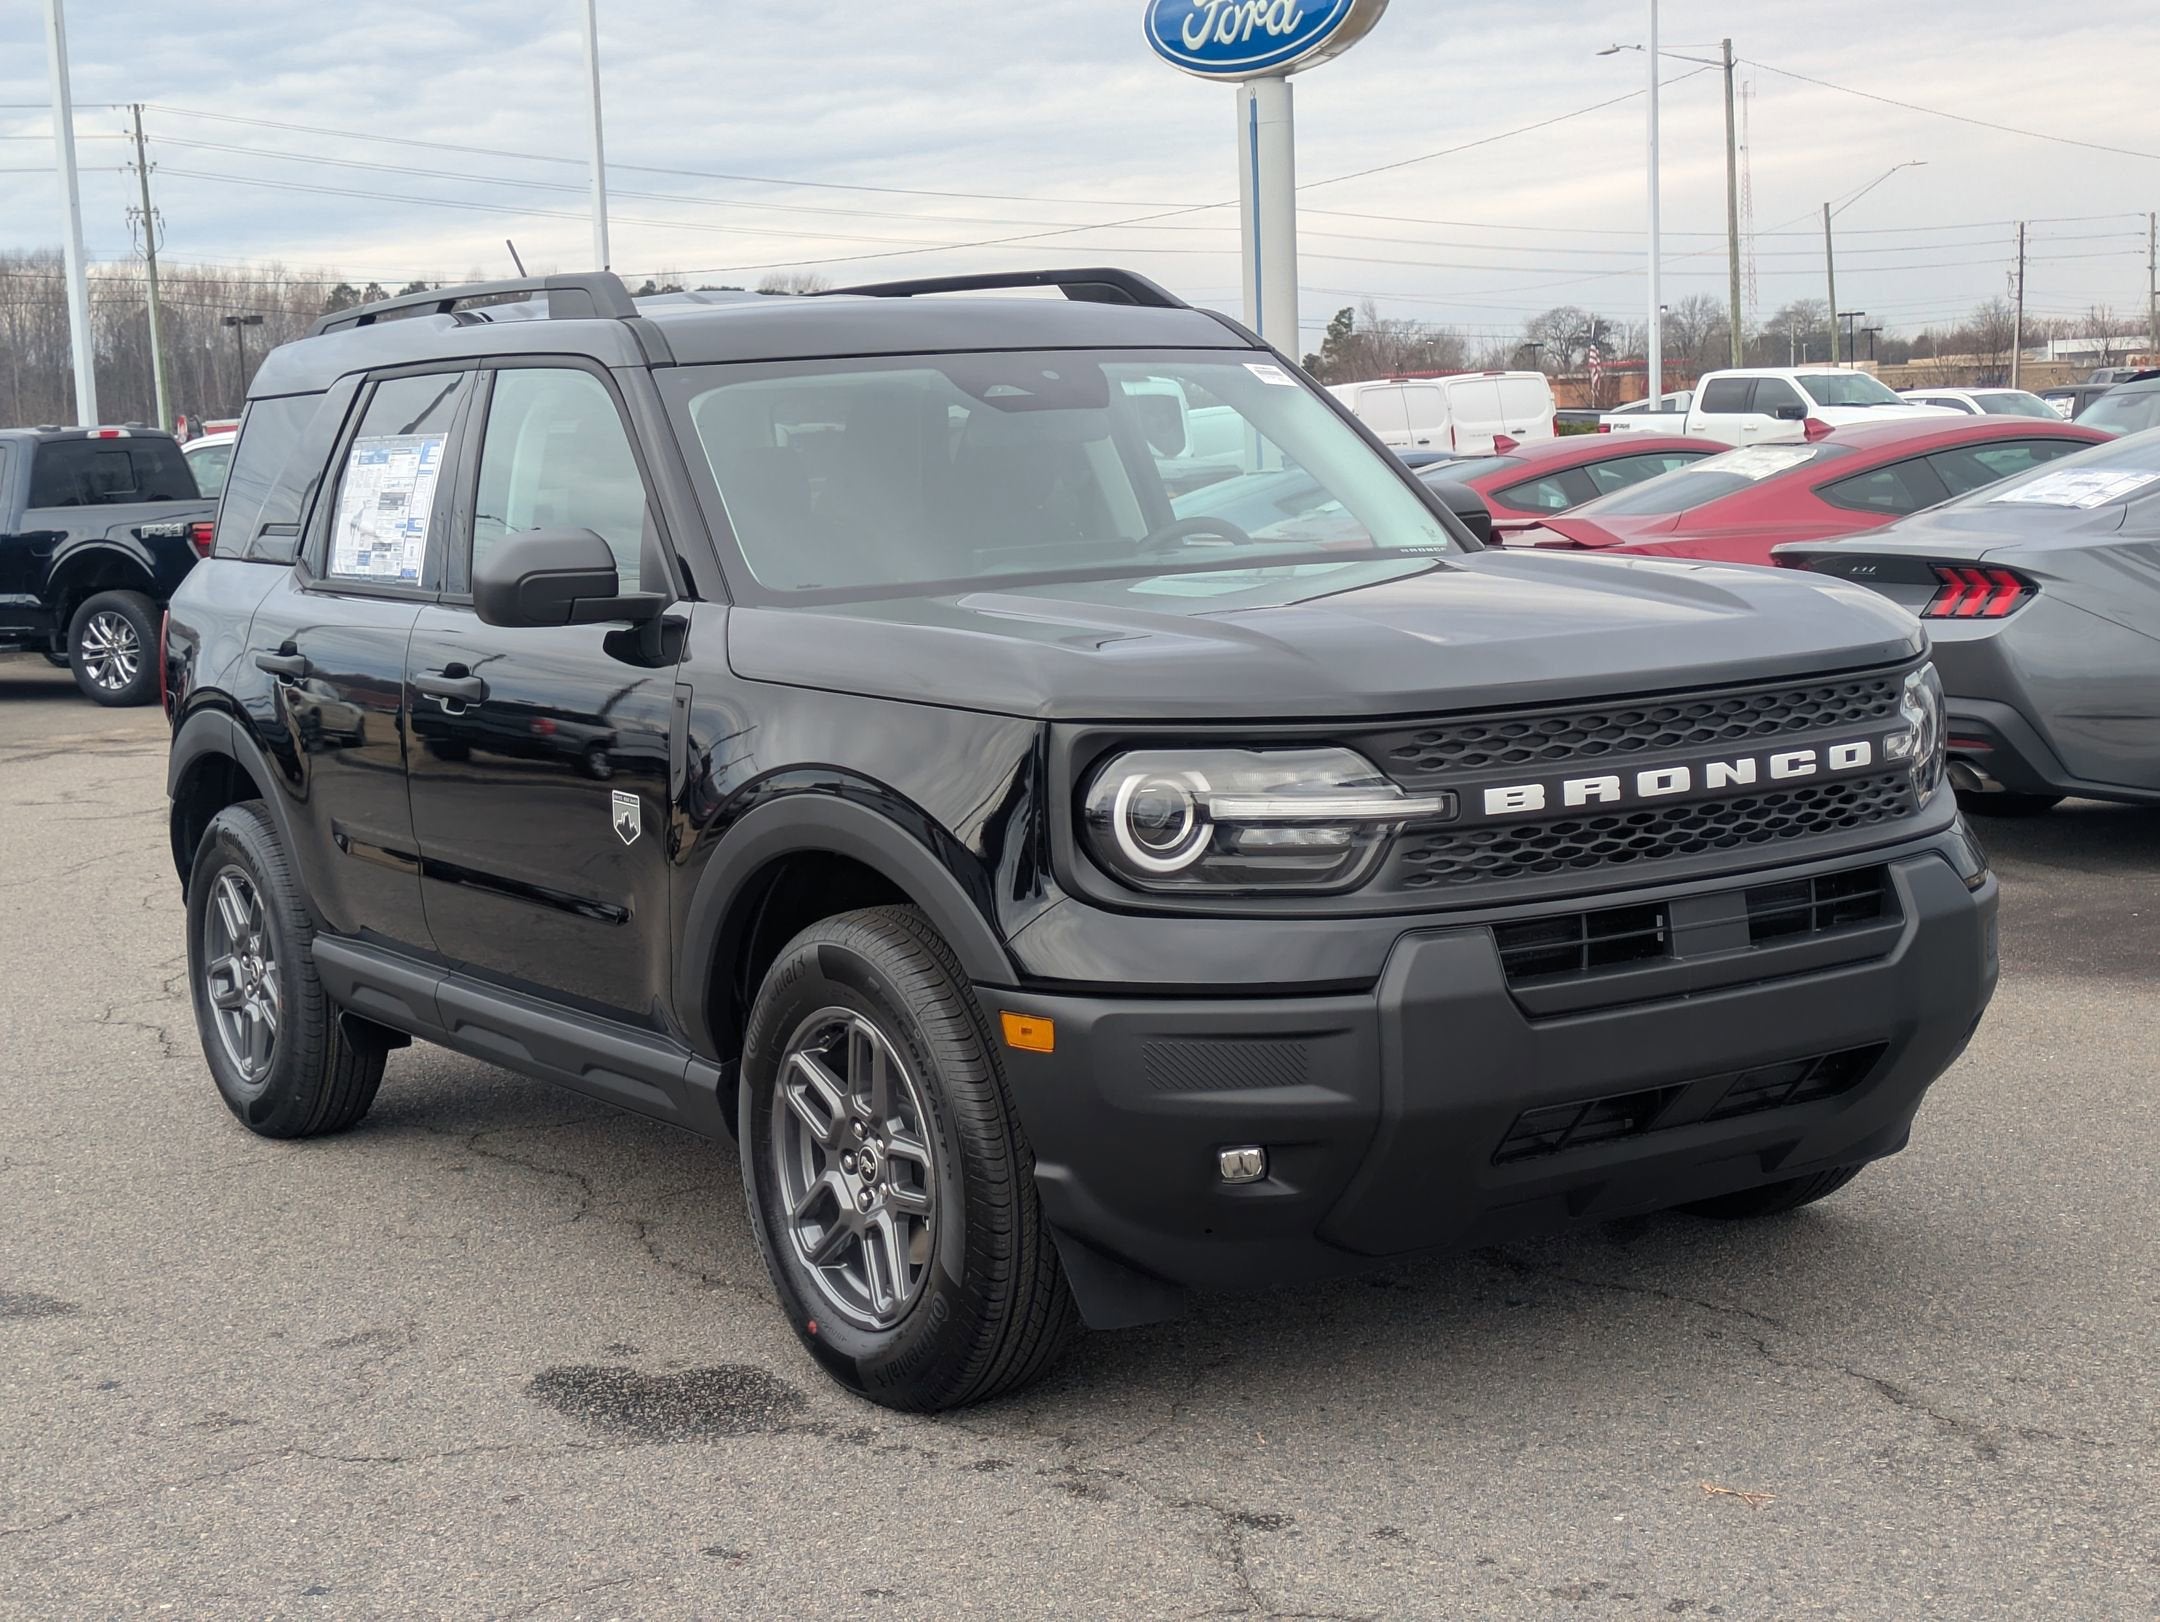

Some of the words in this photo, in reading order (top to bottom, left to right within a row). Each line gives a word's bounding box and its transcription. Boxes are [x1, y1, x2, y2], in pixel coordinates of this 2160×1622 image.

[1182, 0, 1304, 50] Ford
[141, 523, 184, 539] FX4
[1484, 741, 1872, 815] BRONCO
